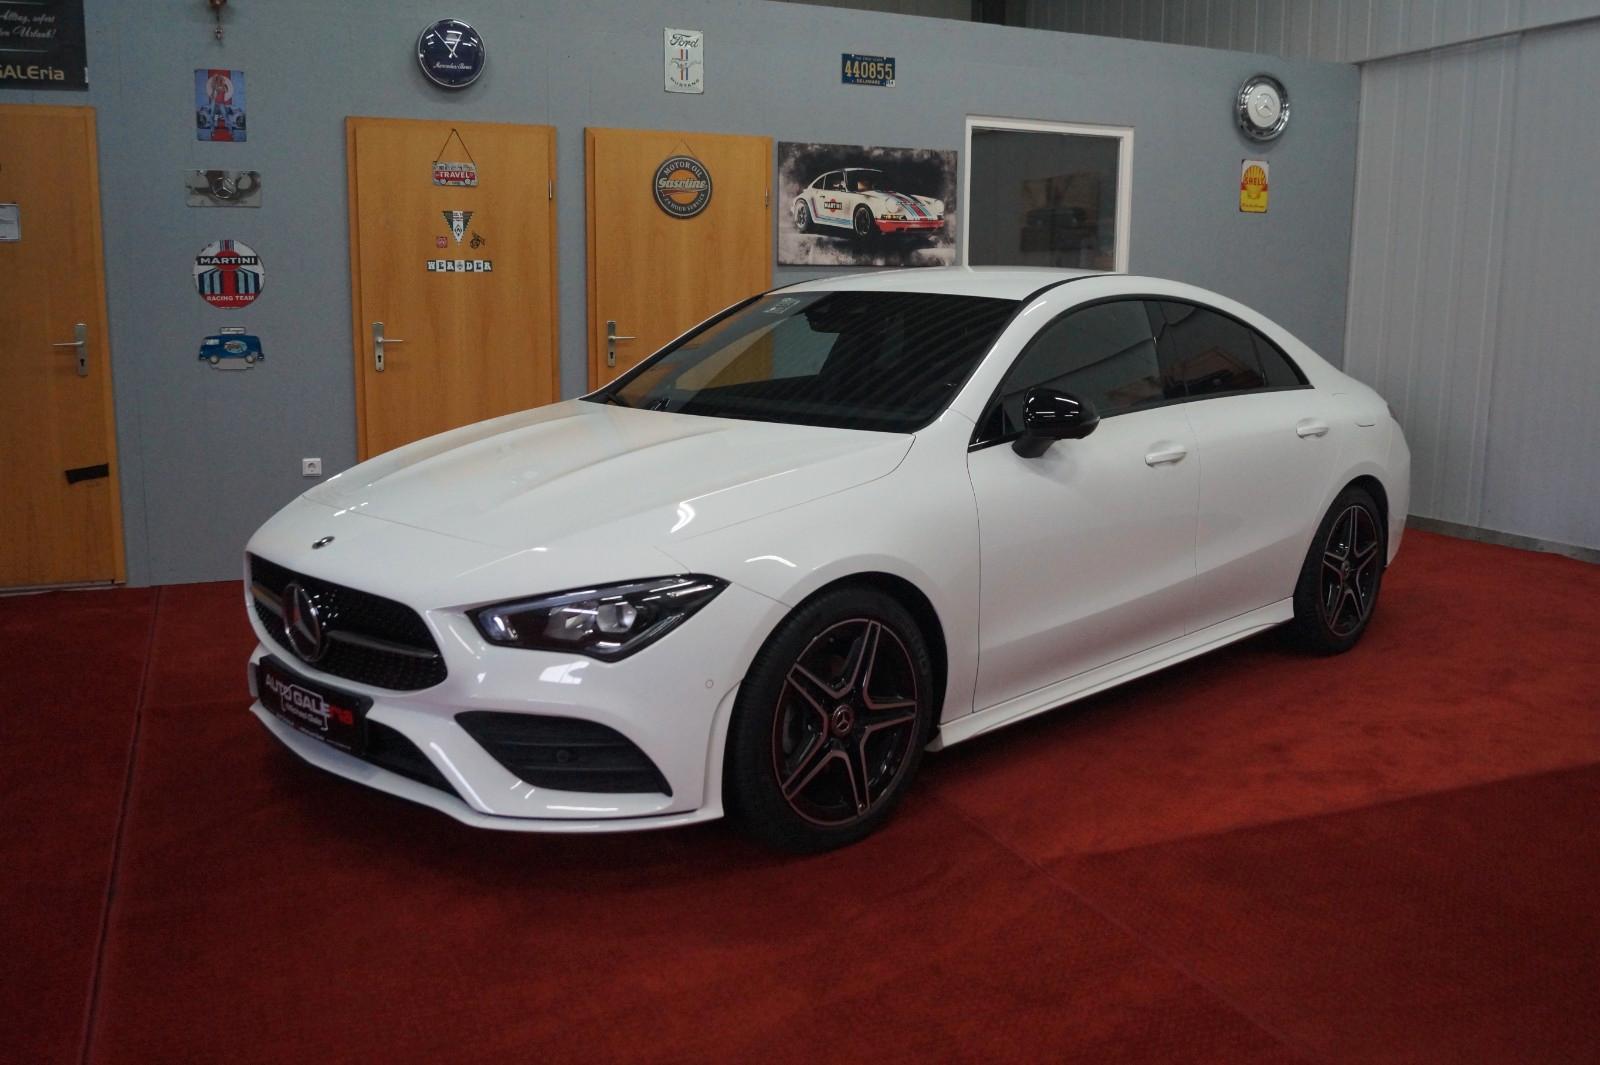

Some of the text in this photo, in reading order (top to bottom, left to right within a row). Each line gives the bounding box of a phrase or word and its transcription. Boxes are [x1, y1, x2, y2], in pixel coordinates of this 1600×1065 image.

[670, 33, 699, 48] Ford
[0, 64, 65, 80] ALEria
[845, 60, 893, 80] 440855
[439, 171, 470, 179] TRAVEL
[663, 160, 704, 178] MOTOR OIL
[200, 256, 255, 264] MARTINI
[265, 673, 292, 700] AUTO
